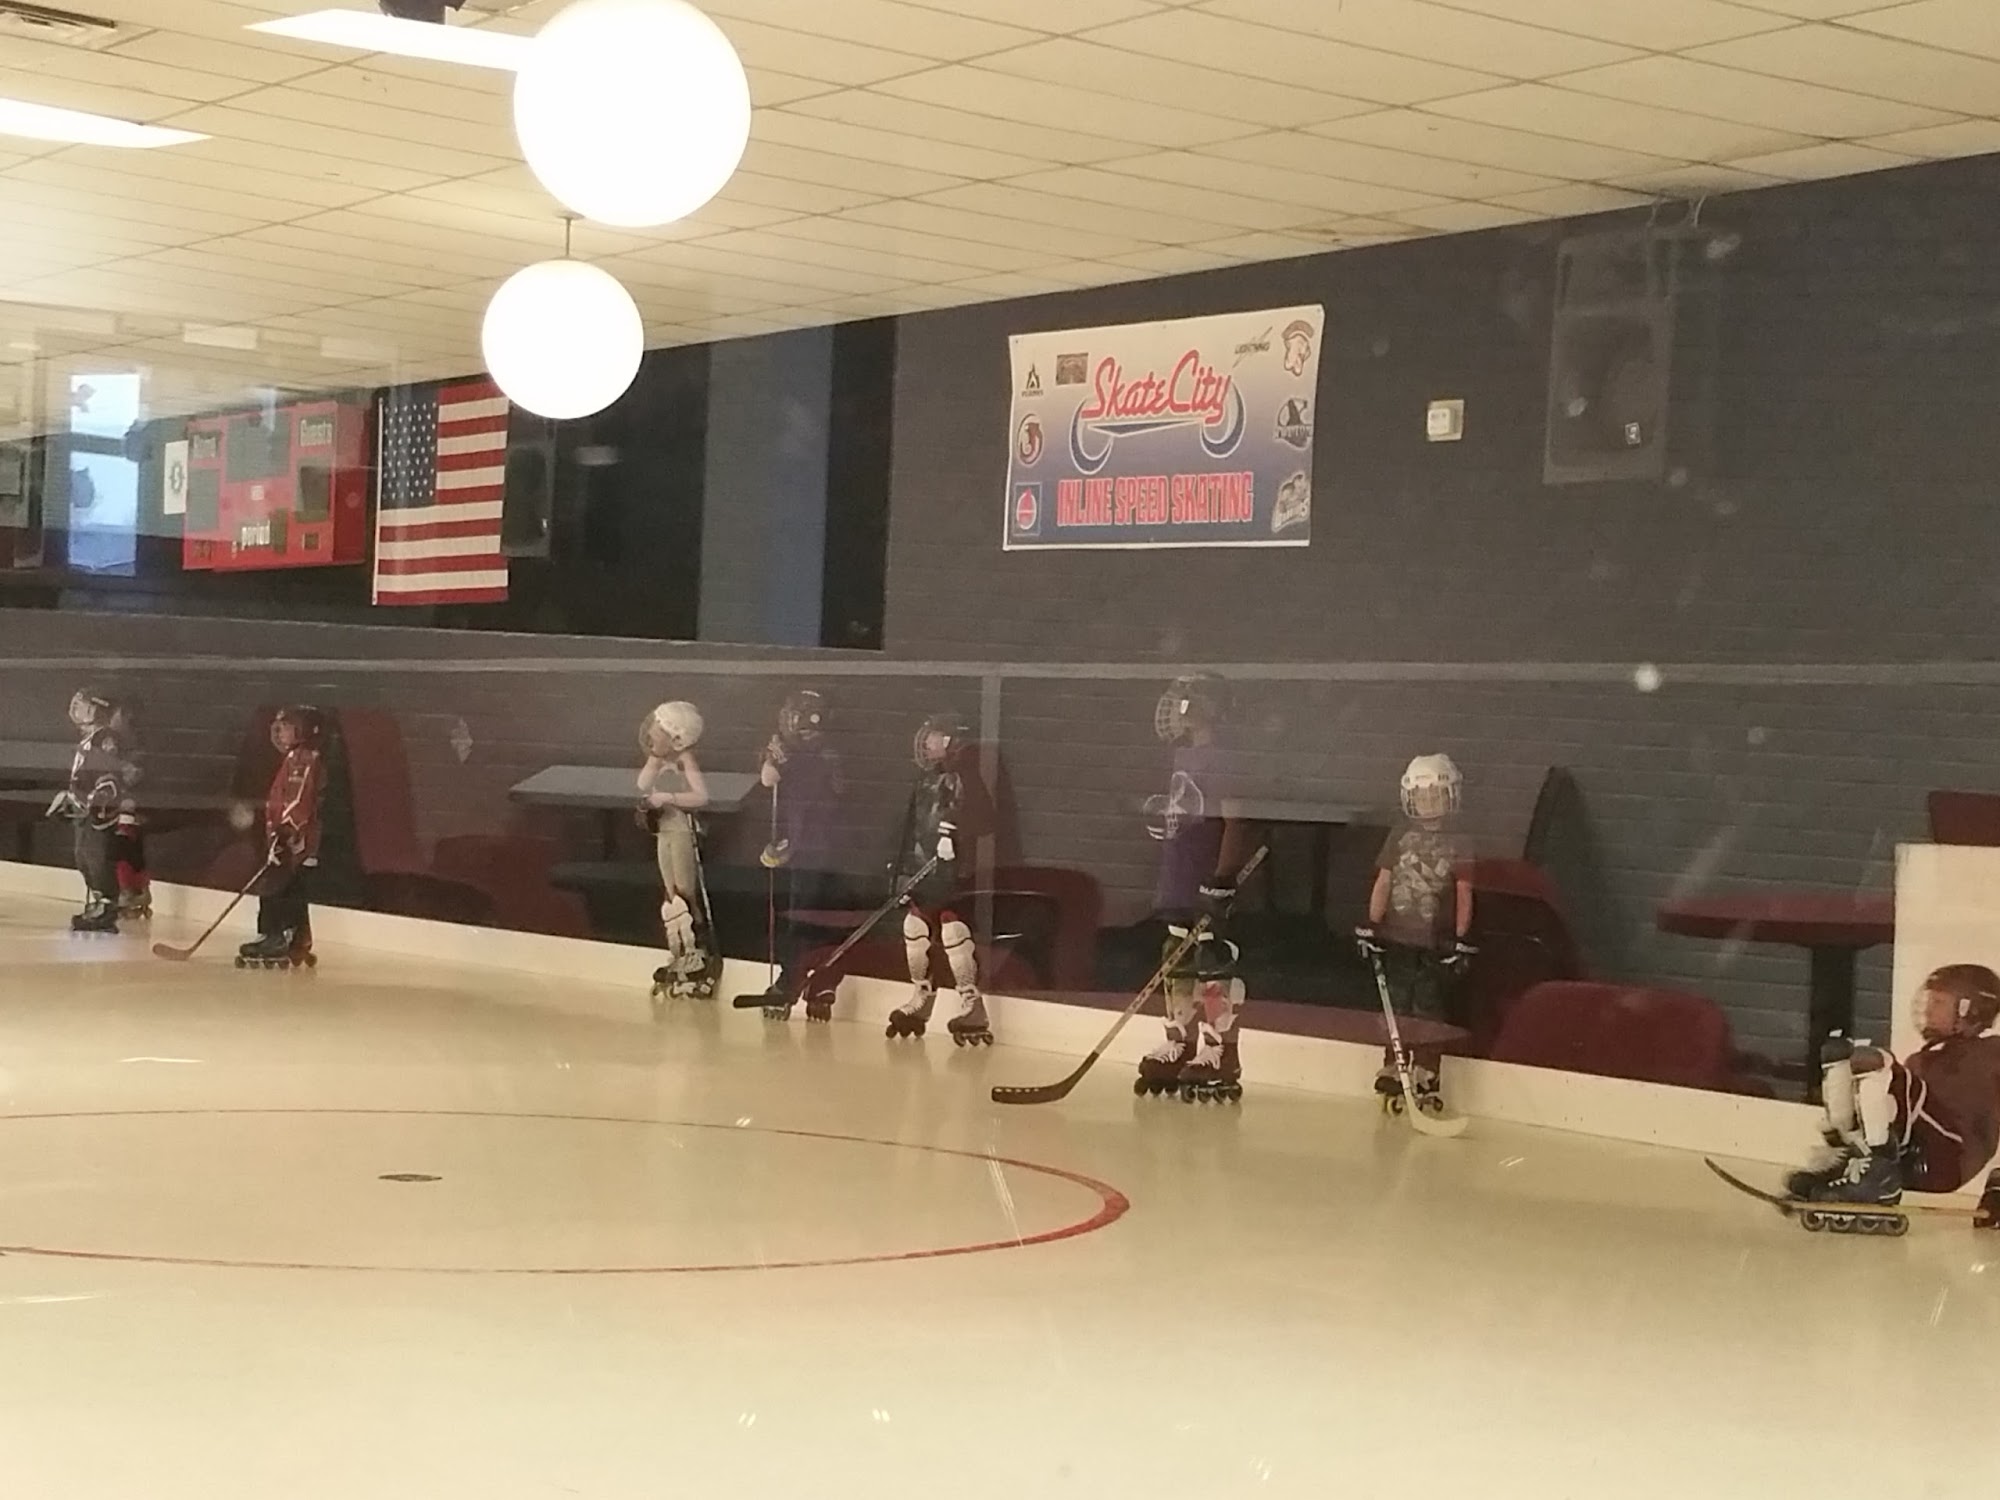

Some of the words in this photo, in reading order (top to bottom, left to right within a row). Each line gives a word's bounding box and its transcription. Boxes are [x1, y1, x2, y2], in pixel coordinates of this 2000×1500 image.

[1080, 356, 1168, 419] Skate
[1168, 349, 1232, 425] City
[1057, 479, 1113, 526] INLINE
[1114, 475, 1169, 525] SPEED
[1171, 471, 1254, 524] SKATING
